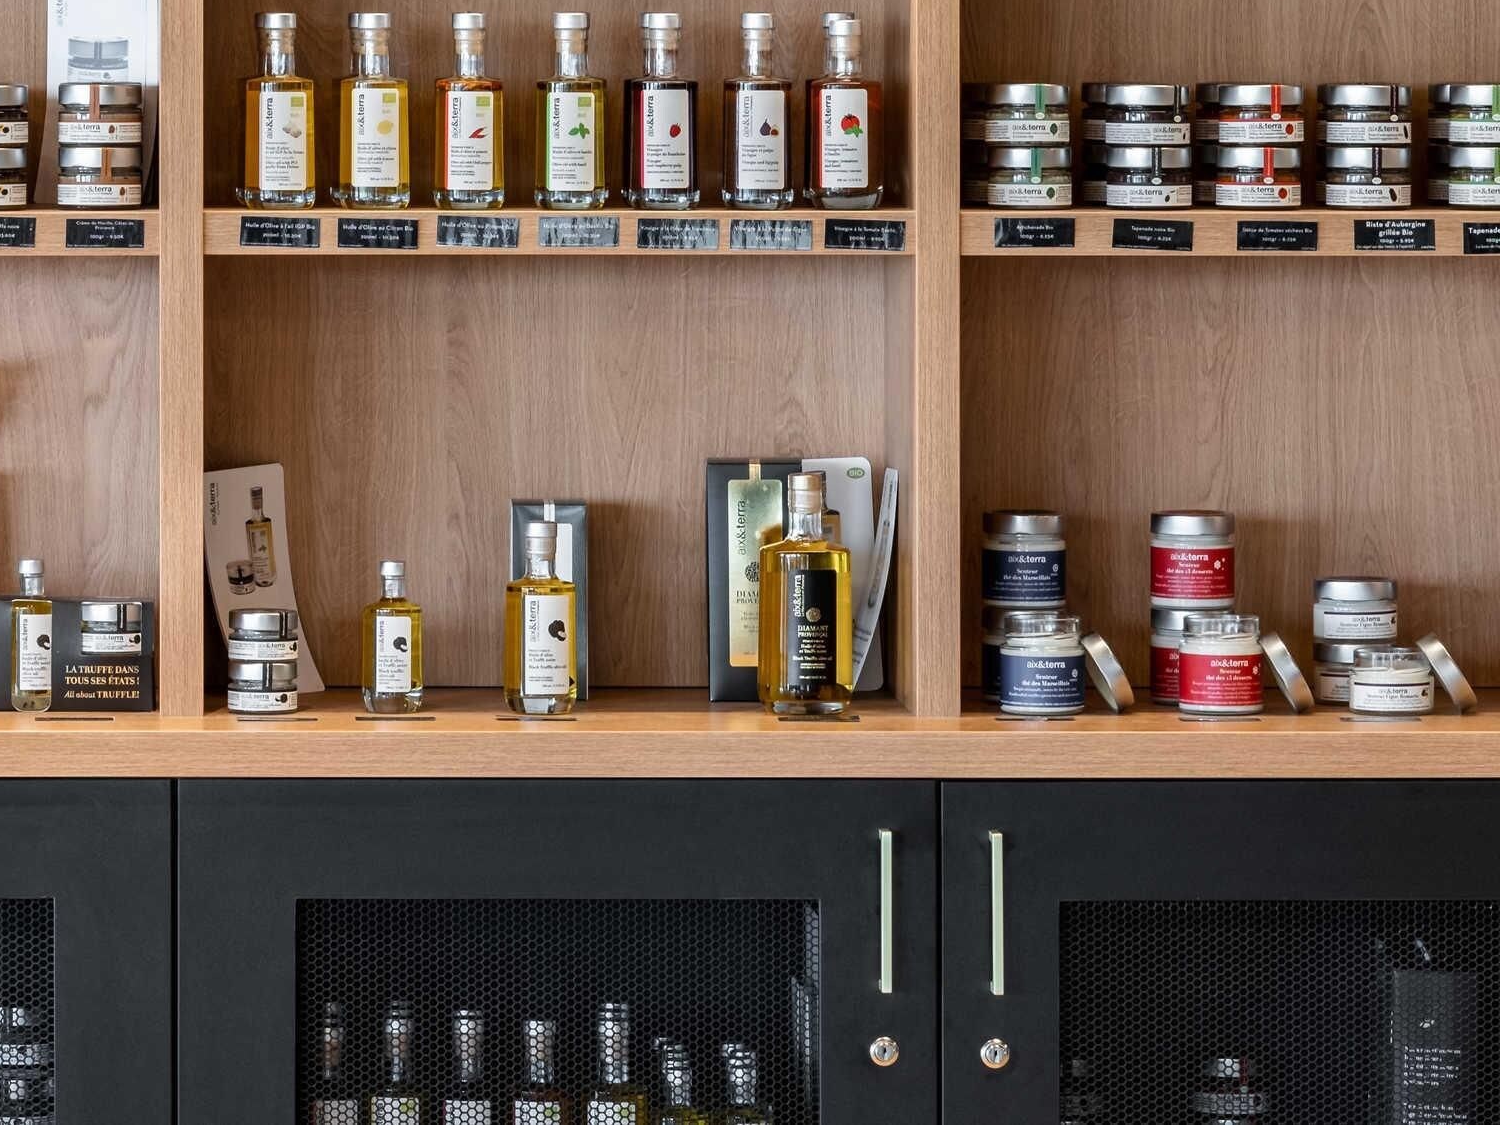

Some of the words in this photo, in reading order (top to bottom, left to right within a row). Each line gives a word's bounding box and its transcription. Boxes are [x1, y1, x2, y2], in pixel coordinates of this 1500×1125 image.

[738, 499, 746, 556] aix&terra
[65, 665, 77, 673] LA
[79, 665, 113, 673] TRUFFE
[115, 665, 140, 673] DANS
[65, 676, 89, 685] TOUS
[91, 676, 107, 685] SES
[108, 675, 135, 685] ÉTATS
[64, 690, 74, 699] All
[76, 690, 96, 699] about
